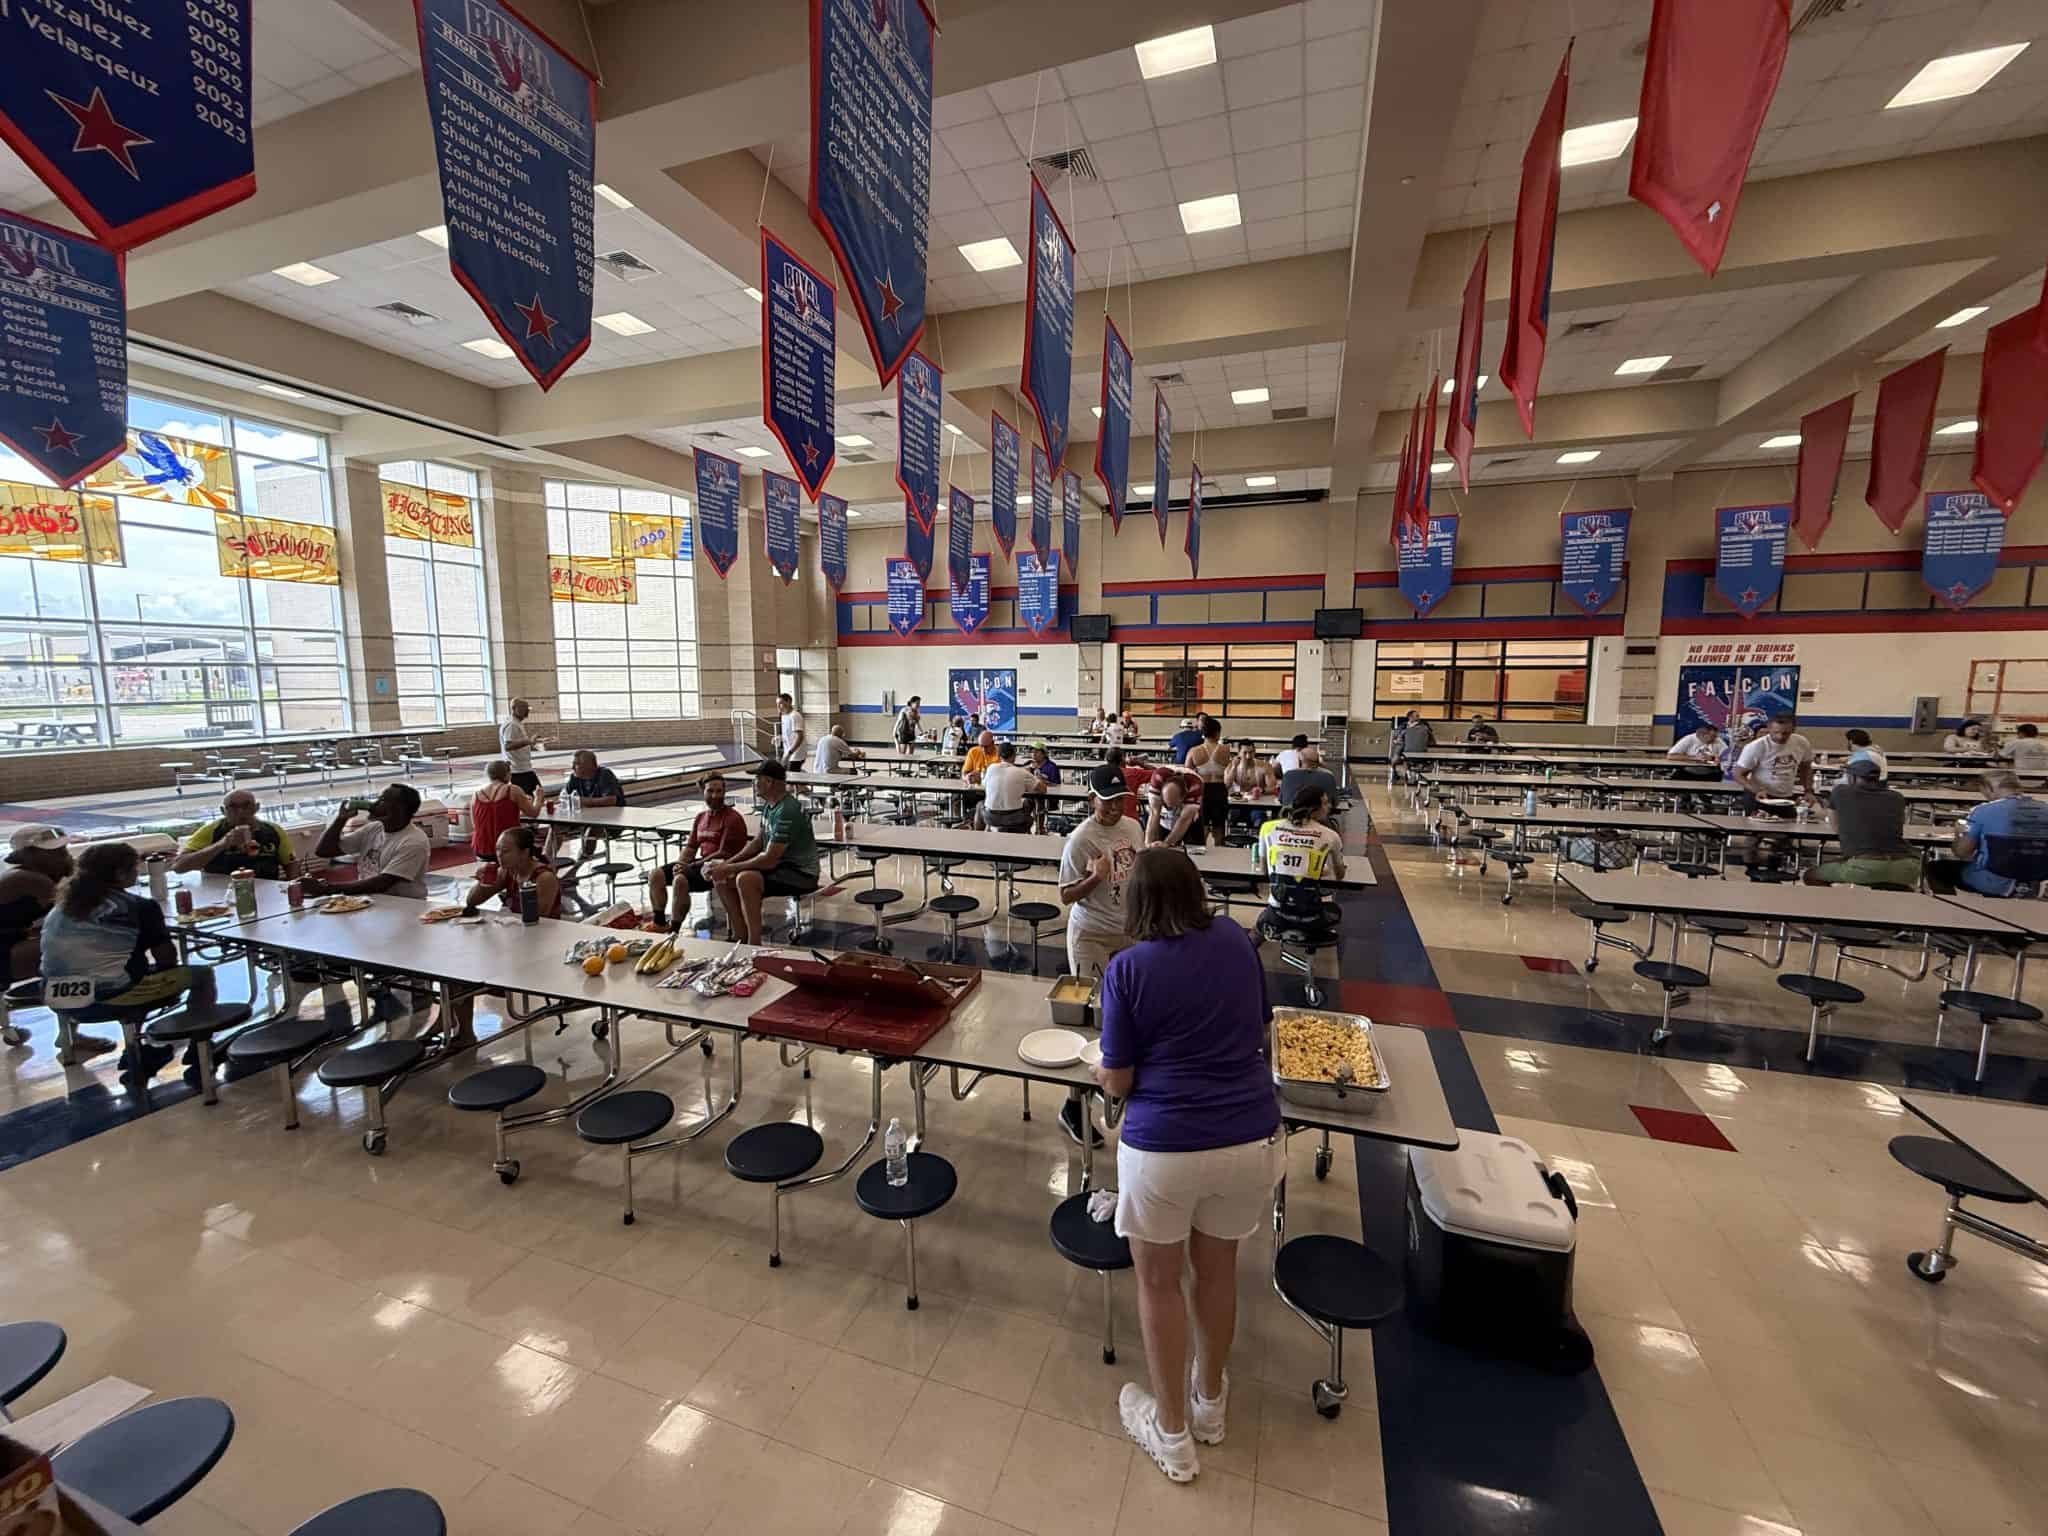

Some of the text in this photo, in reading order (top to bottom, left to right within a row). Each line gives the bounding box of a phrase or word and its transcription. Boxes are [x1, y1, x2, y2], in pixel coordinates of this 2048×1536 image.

[185, 0, 241, 47] 2022
[203, 0, 240, 22] 22
[21, 7, 243, 96] Velasqeuz 2022
[188, 24, 241, 71] 2022
[192, 75, 245, 120] 2023
[195, 103, 247, 145] 2023
[439, 81, 494, 129] Stephen
[498, 121, 542, 160] Morgan
[440, 121, 490, 161] Shauna
[493, 153, 531, 185] Odum
[484, 132, 523, 163] Alfaro
[444, 158, 592, 252] Samantha Lopez 202
[446, 179, 500, 216] Alondra
[503, 208, 559, 247] Melendez
[447, 195, 482, 223] Katia
[571, 217, 592, 237] 202
[449, 215, 489, 244] Angel
[492, 234, 552, 275] Velasquez
[1686, 654, 1796, 663] ALLOWED IN THE GYM
[1688, 643, 1795, 653] NO FOOD OR DRINKS
[953, 675, 1012, 693] FALCON
[1688, 673, 1791, 698] FALCON
[1278, 833, 1314, 846] Circus
[1282, 854, 1303, 868] 317
[51, 981, 91, 998] 1023
